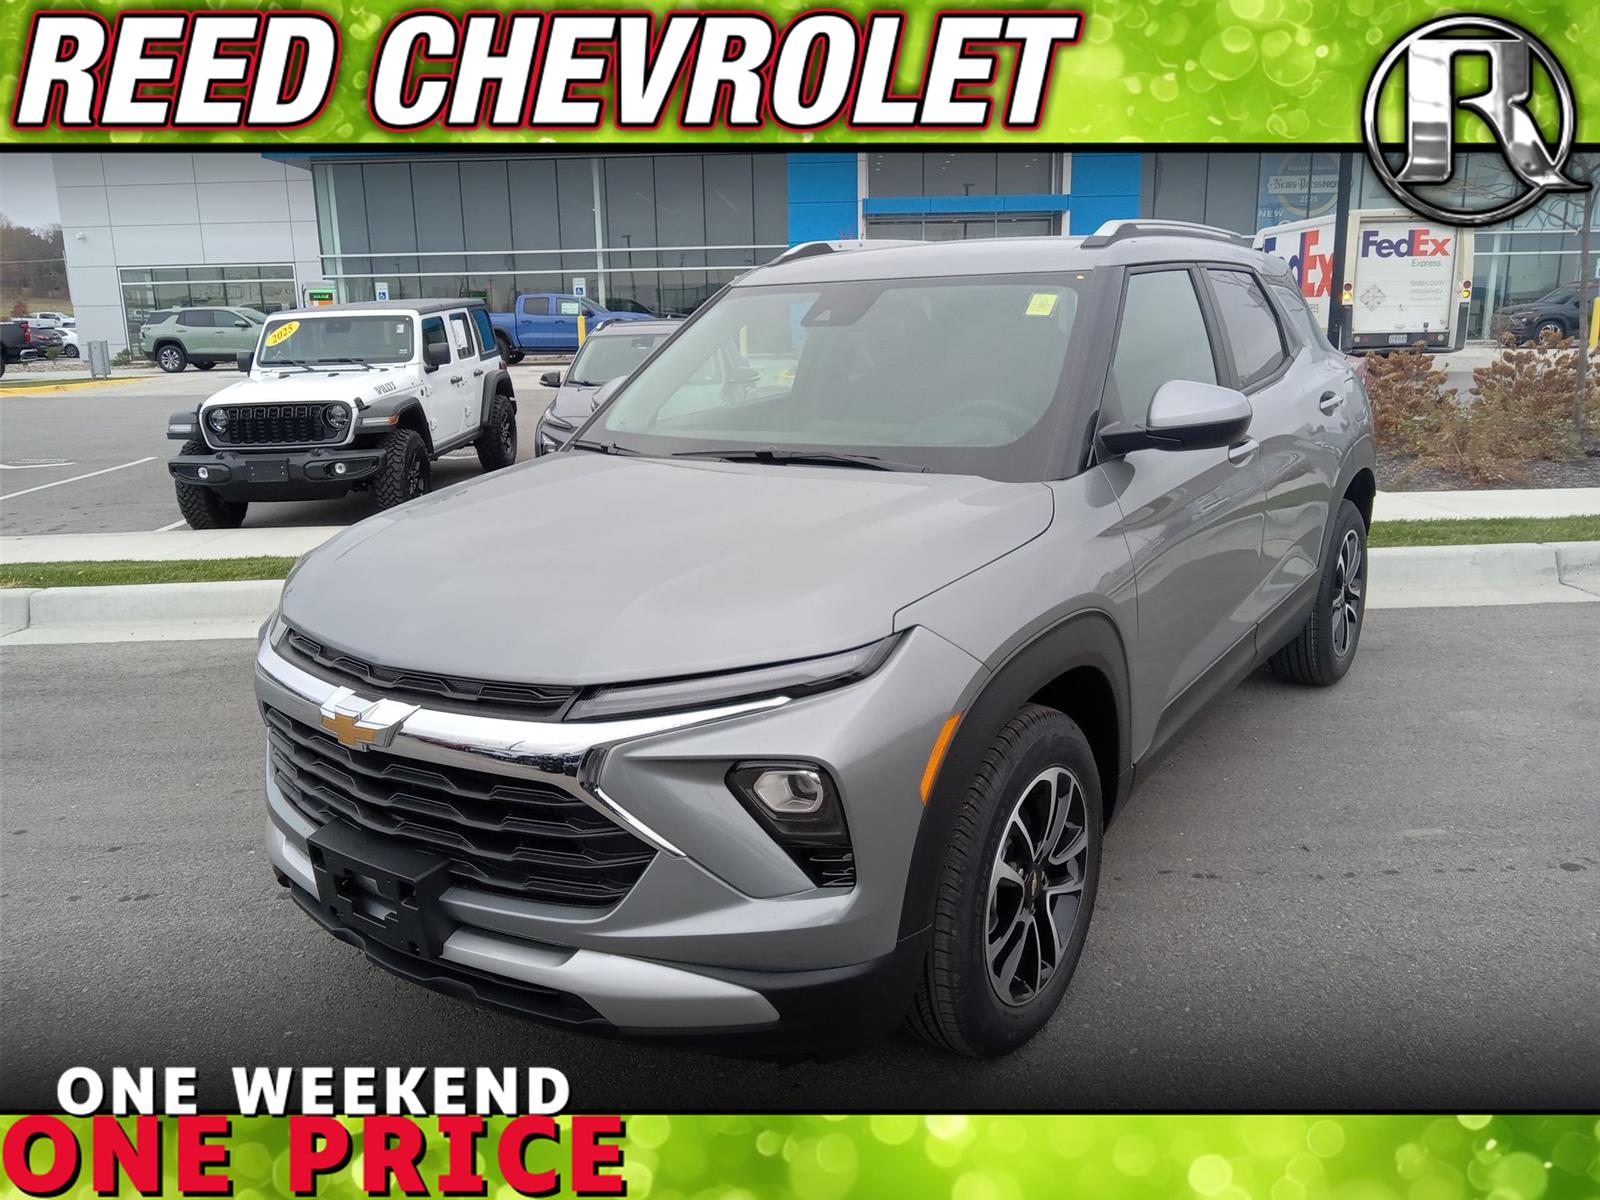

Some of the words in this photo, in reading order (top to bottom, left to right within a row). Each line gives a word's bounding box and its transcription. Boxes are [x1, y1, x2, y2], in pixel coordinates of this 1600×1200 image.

[1361, 229, 1451, 258] FedEx
[1411, 259, 1442, 267] Express
[271, 324, 294, 344] 2025
